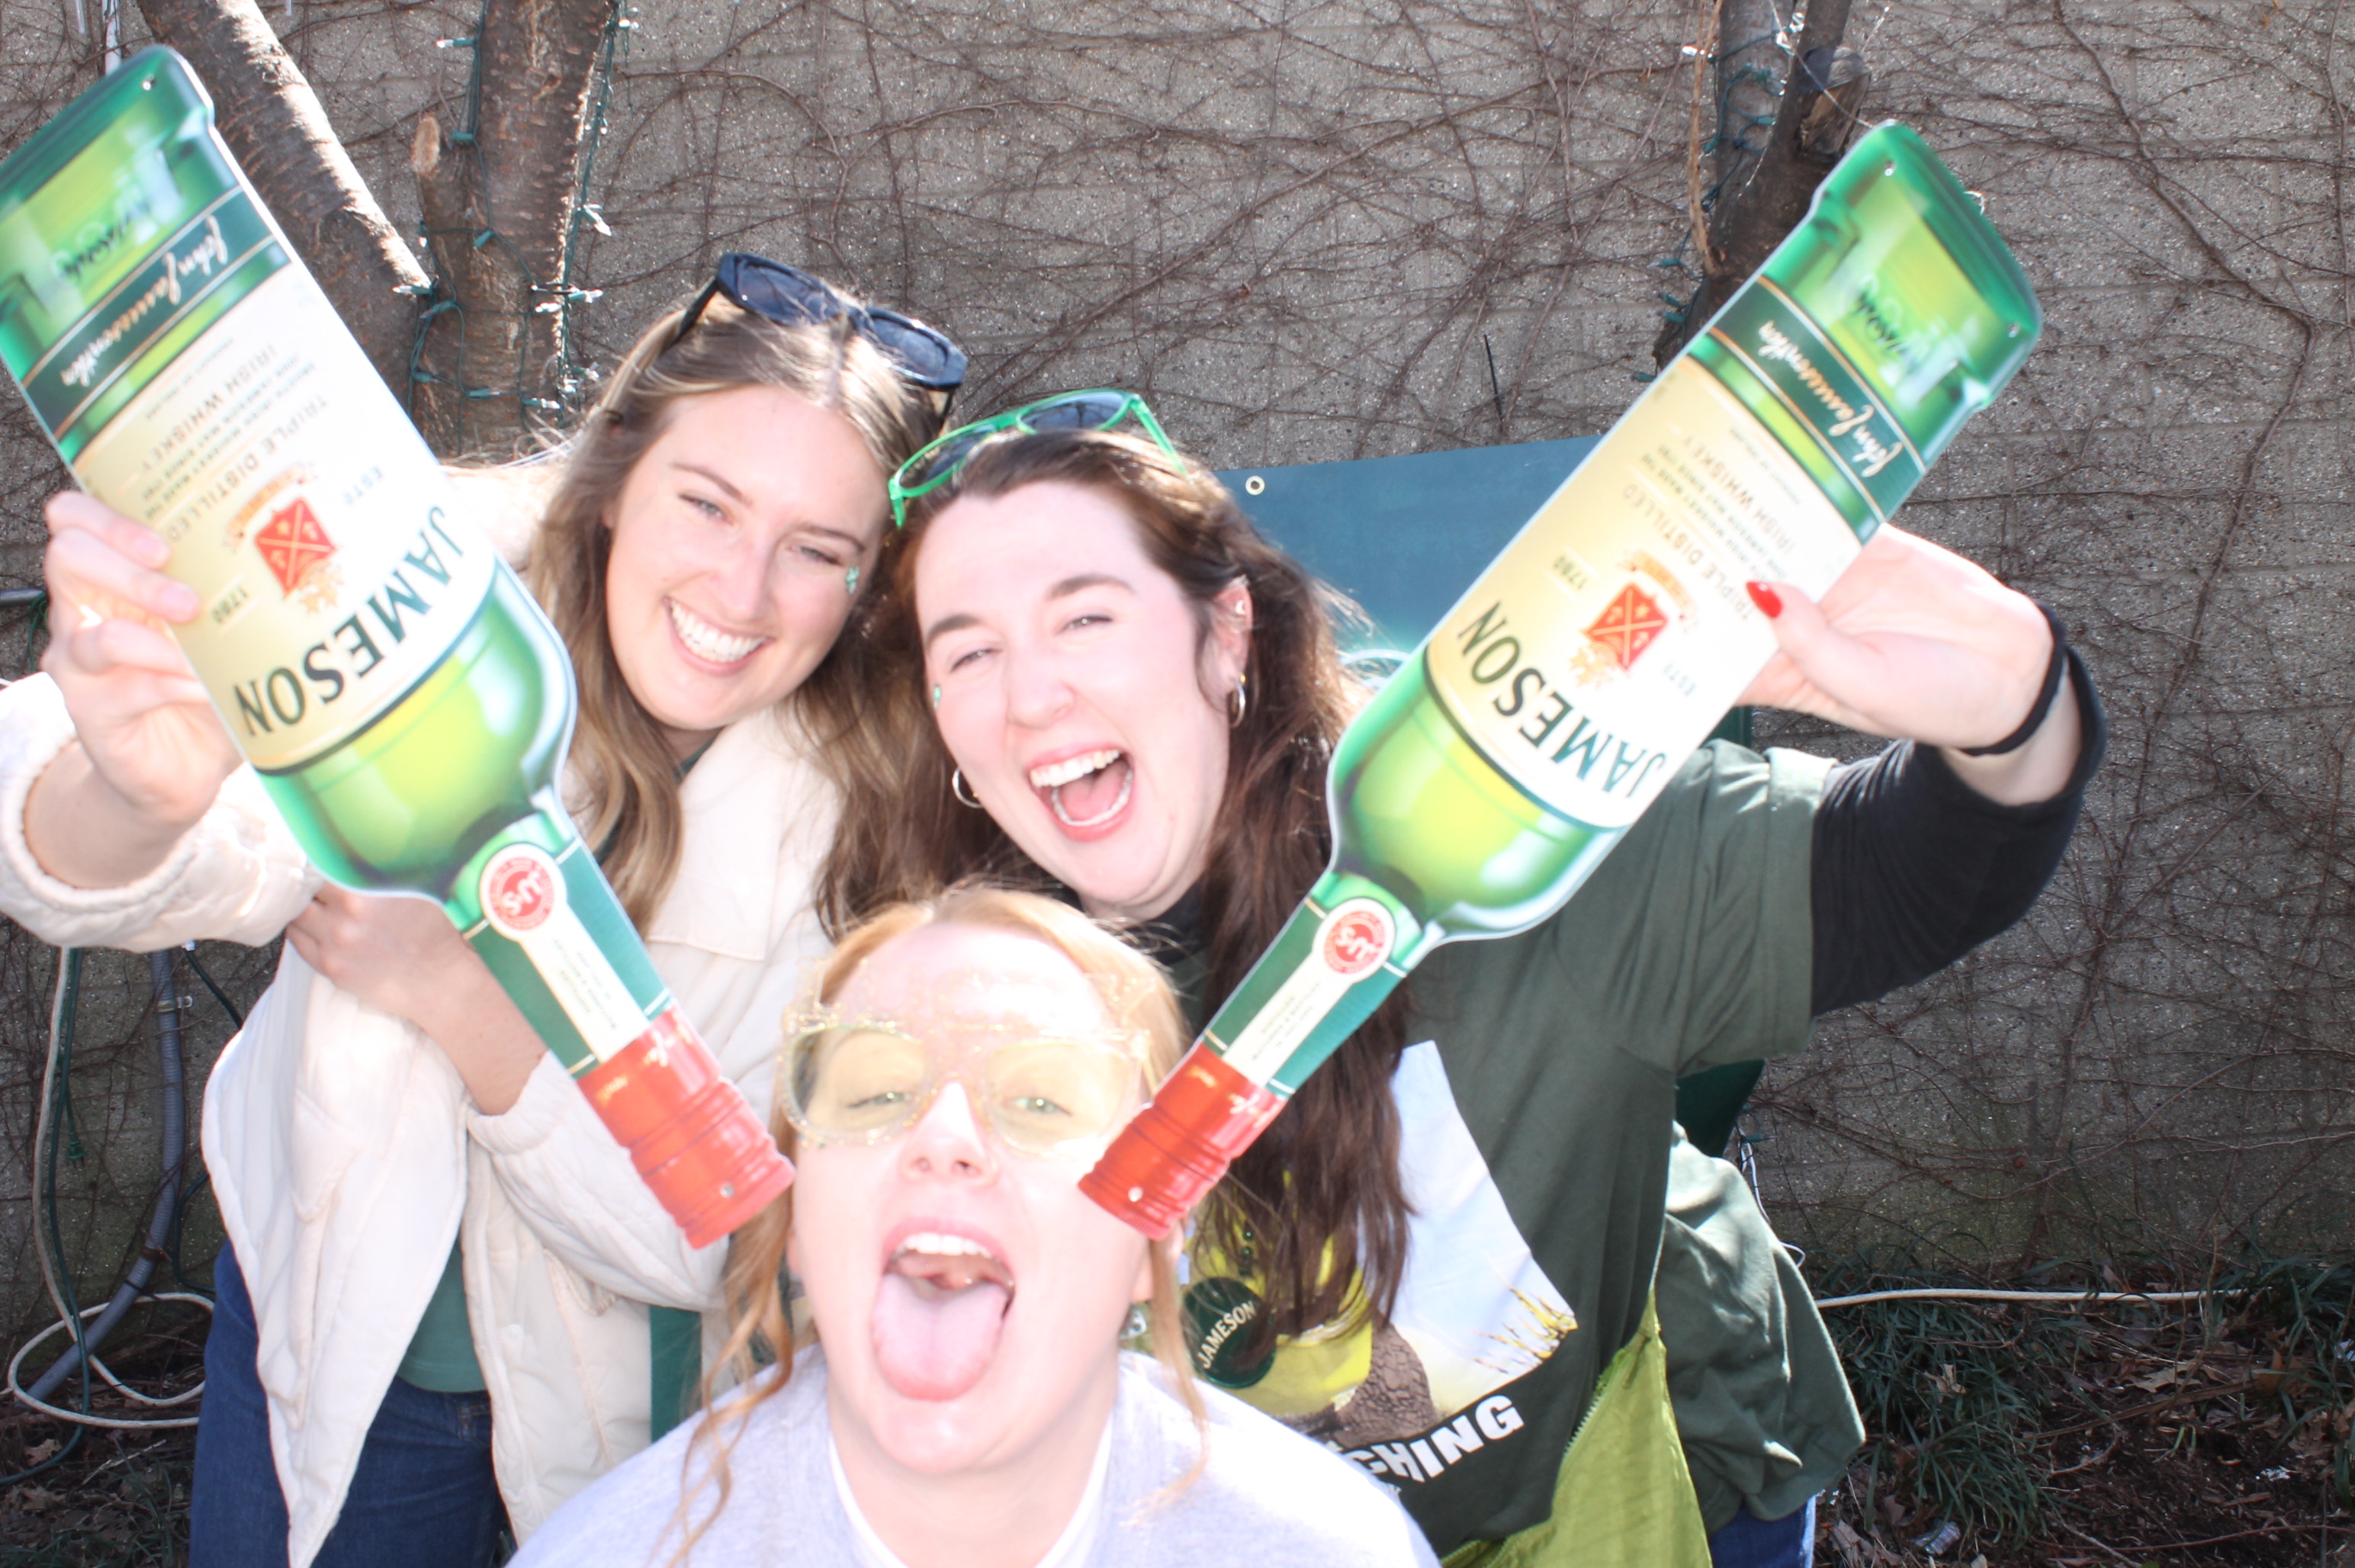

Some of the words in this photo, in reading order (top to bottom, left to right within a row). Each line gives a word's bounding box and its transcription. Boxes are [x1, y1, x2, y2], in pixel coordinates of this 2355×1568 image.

[223, 344, 278, 395] IRISH
[137, 390, 225, 475] WHISKEY
[259, 394, 329, 455] TRIPLE
[163, 451, 261, 545] DISTILLED
[1680, 432, 1756, 510] WHISKEY
[1618, 480, 1705, 568] DISTILLED
[1751, 506, 1796, 555] IRISH
[208, 586, 250, 625] 1780
[1550, 553, 1589, 591] 1780
[1698, 561, 1755, 622] TRIPLE
[234, 506, 464, 736] JAMESON
[1457, 601, 1666, 798] JAMESON
[1197, 1300, 1257, 1369] JAMESON
[1327, 1394, 1524, 1483] CHING
